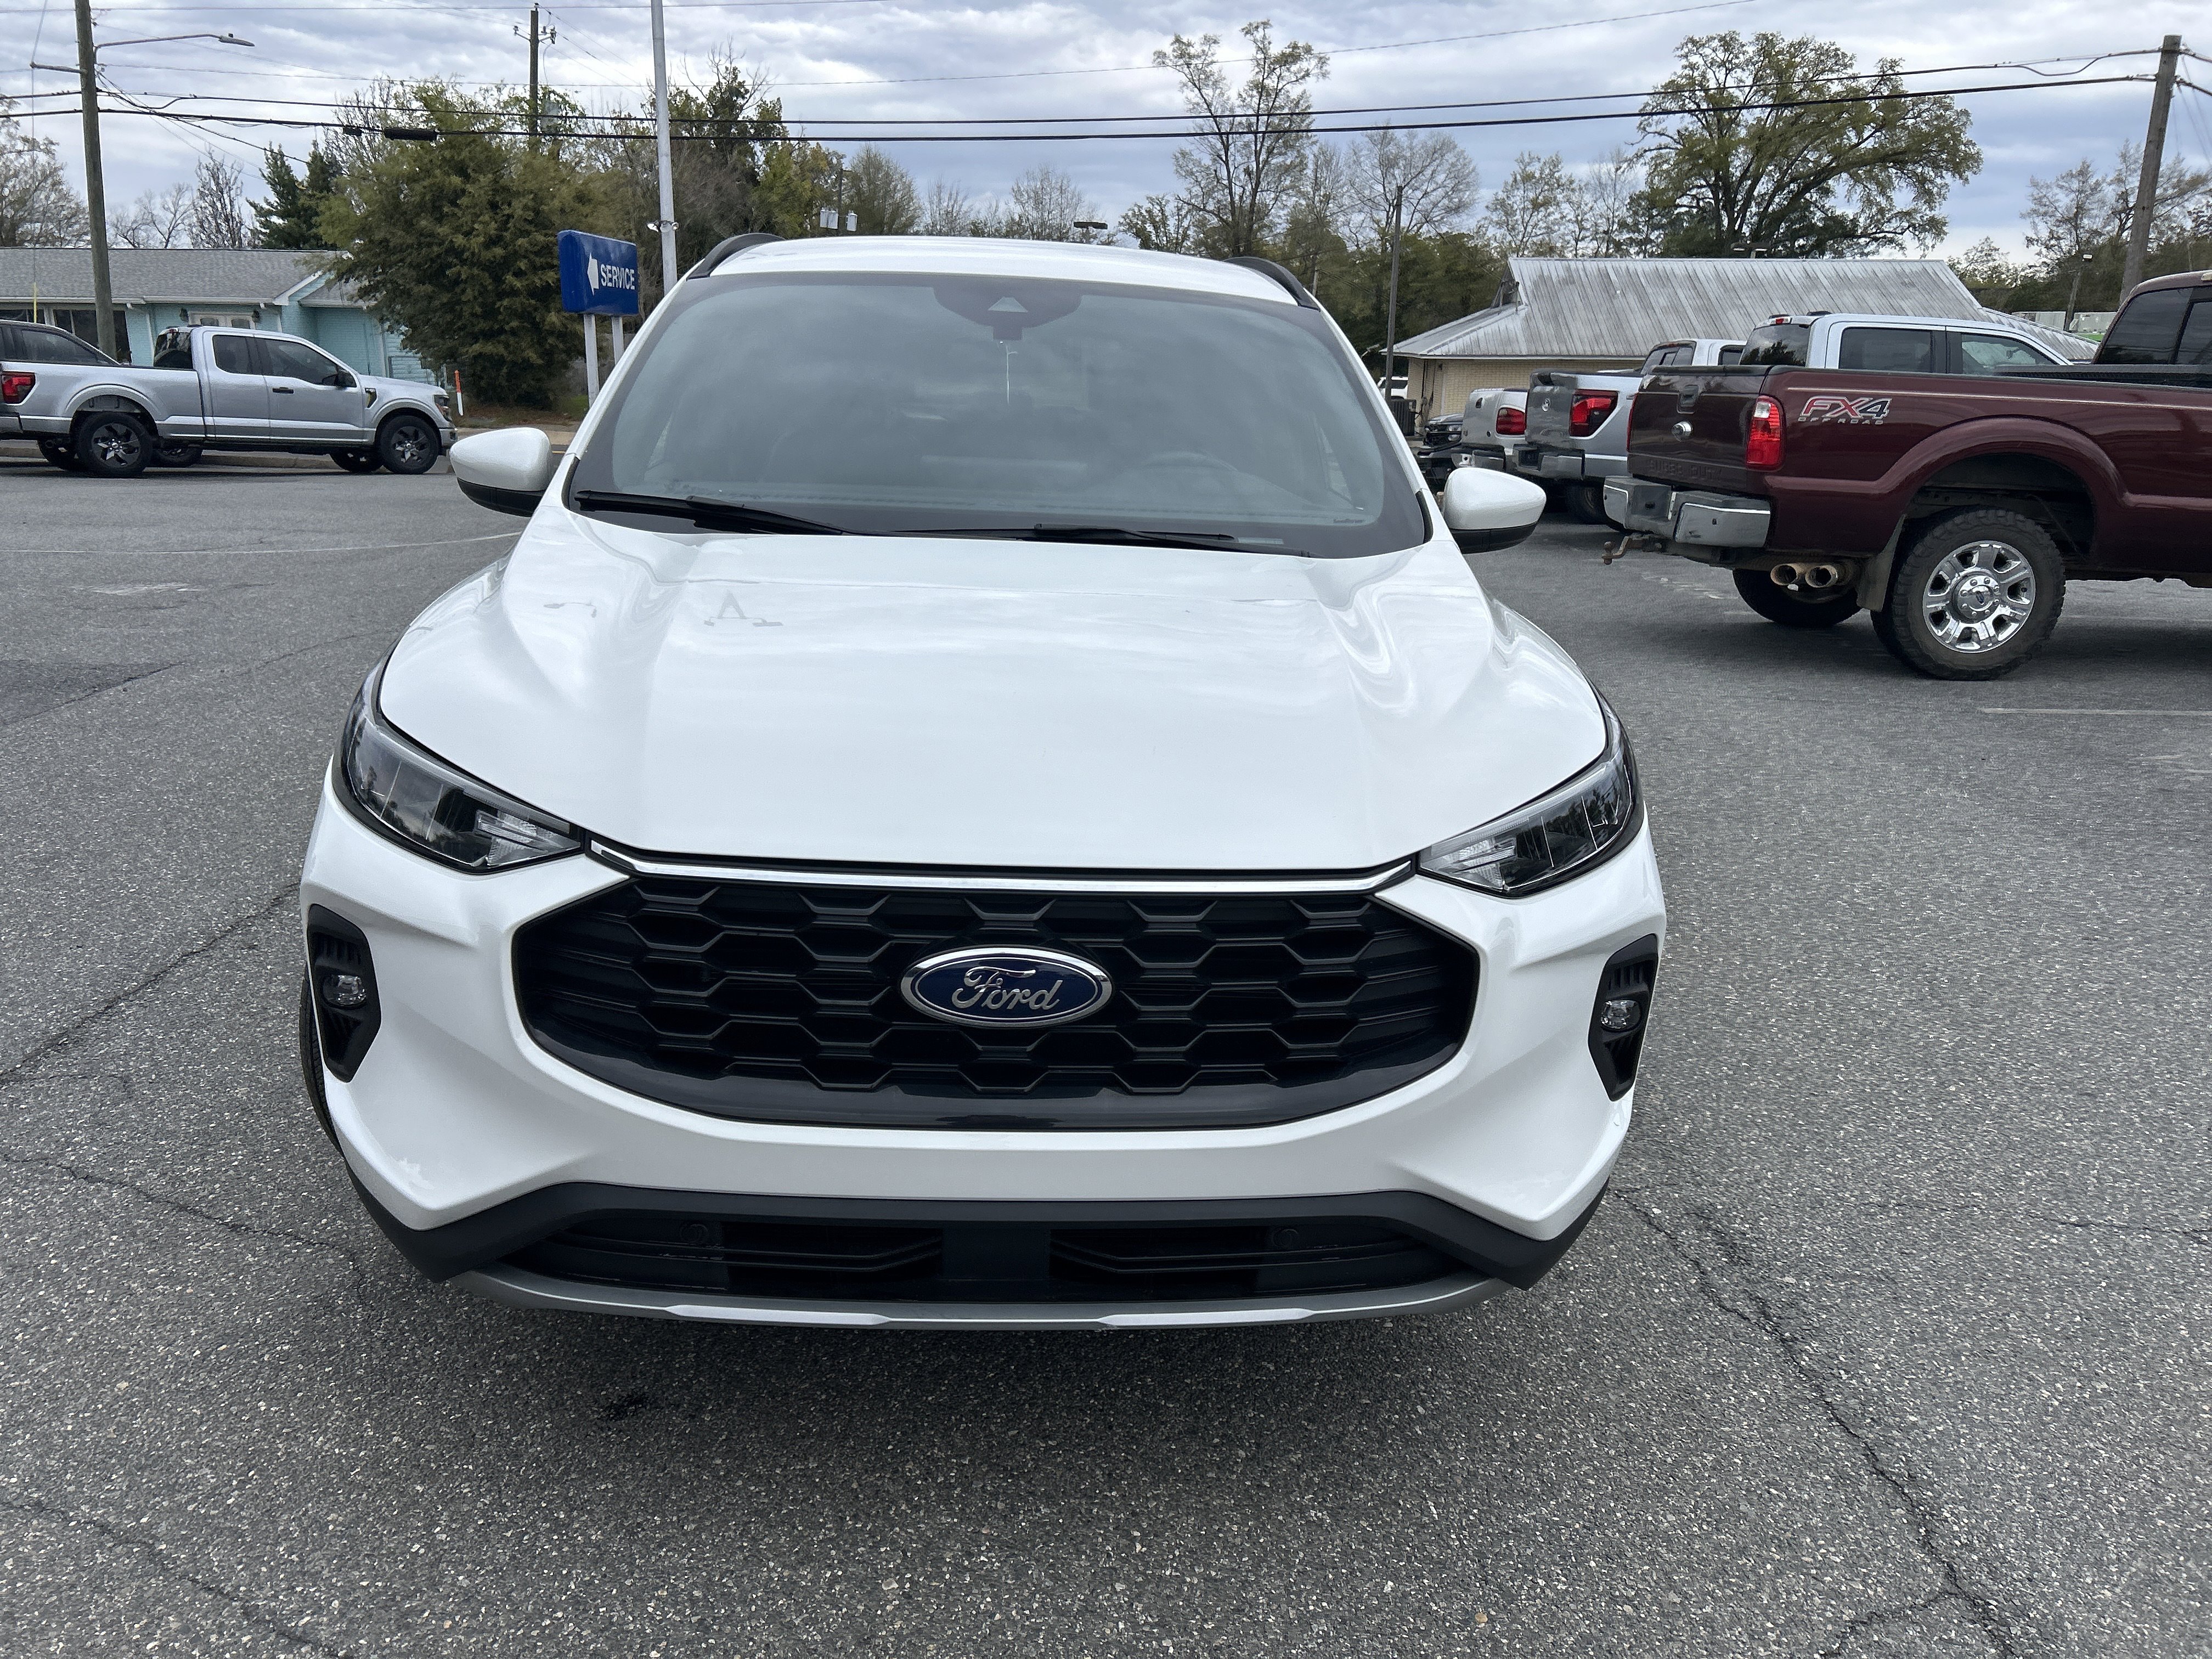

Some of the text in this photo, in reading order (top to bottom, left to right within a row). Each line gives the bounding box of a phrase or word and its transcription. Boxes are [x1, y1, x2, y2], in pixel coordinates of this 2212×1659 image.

[600, 264, 635, 290] SERVICE
[1800, 396, 1892, 419] FX4
[951, 966, 1063, 1010] Ford
